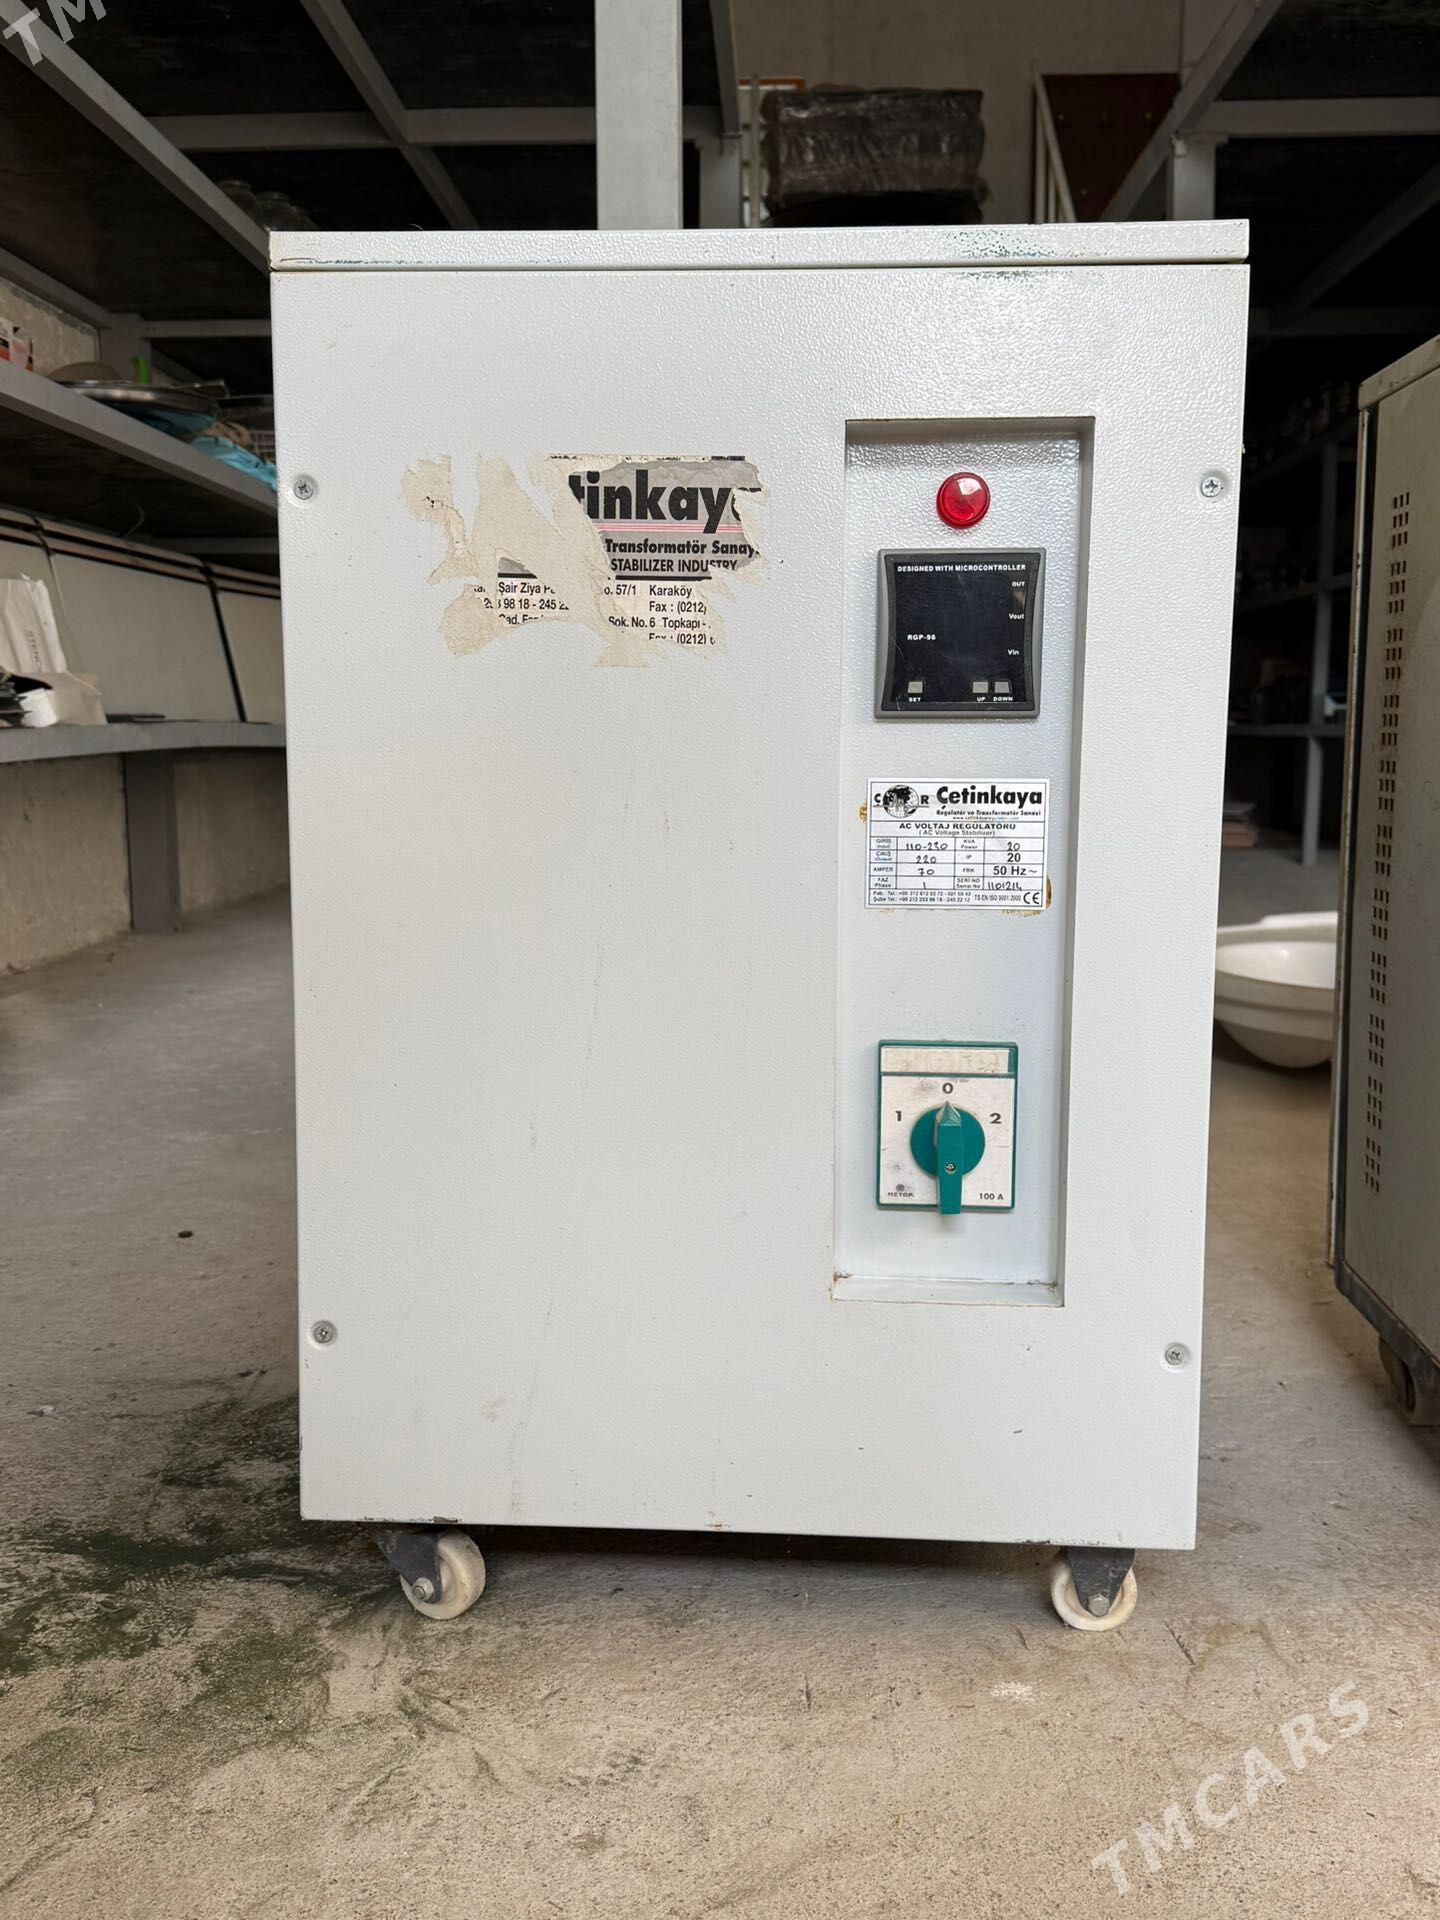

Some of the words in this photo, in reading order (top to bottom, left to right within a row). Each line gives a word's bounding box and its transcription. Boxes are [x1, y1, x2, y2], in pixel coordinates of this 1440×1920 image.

[604, 538, 707, 555] Transformatör
[610, 558, 674, 572] STABILIZER
[954, 564, 1026, 572] MICROCONTROLLER
[498, 582, 518, 596] Şair
[520, 582, 541, 596] Ziya
[616, 584, 637, 596] 57/1
[649, 585, 692, 598] Karaköy
[503, 598, 515, 609] 98
[519, 598, 530, 609] 18
[539, 599, 557, 610] 245
[649, 601, 667, 612] Fax
[631, 617, 648, 628] No.
[649, 617, 656, 628] 6
[662, 617, 700, 630] Topkapı
[676, 633, 707, 645] (0212)
[936, 785, 1042, 809] Çetinkaya
[916, 854, 937, 864] 220
[1007, 852, 1021, 862] 20
[993, 865, 1007, 875] 50
[1011, 865, 1027, 875] Hz
[942, 1082, 954, 1094] 0
[895, 1110, 902, 1122] 1
[989, 1112, 1002, 1124] 2
